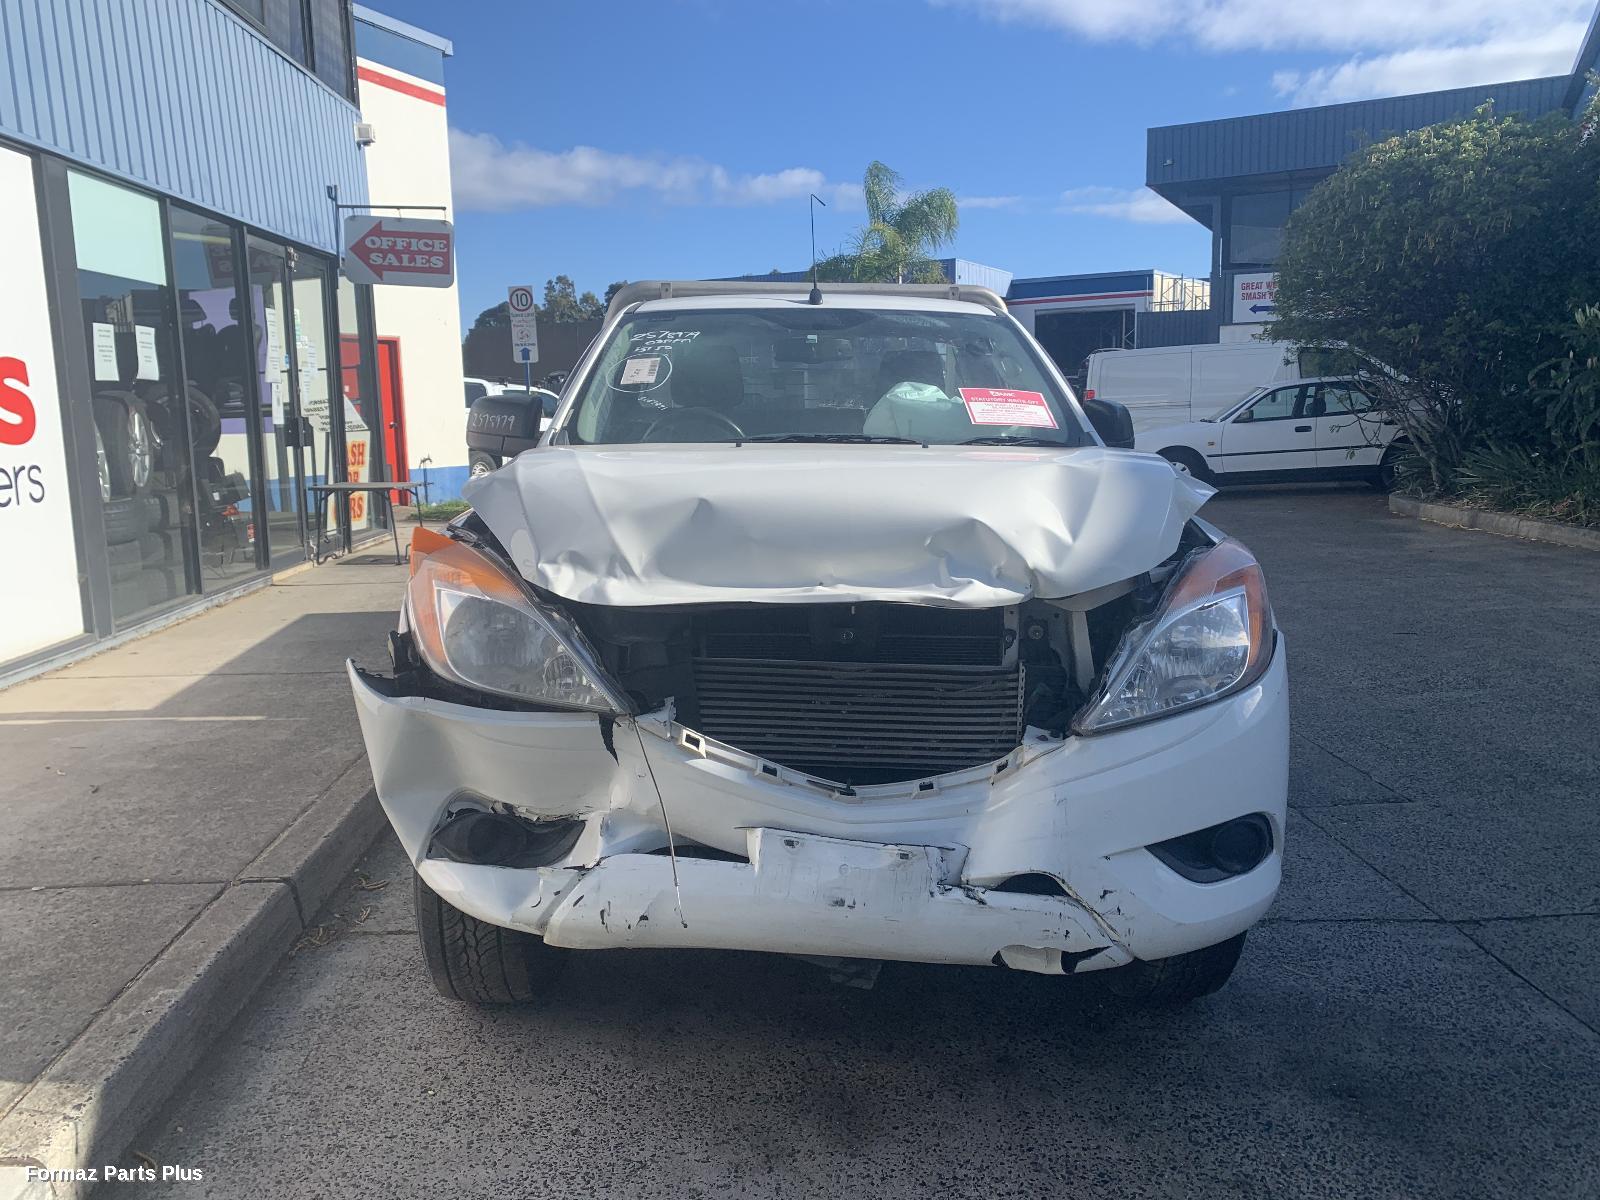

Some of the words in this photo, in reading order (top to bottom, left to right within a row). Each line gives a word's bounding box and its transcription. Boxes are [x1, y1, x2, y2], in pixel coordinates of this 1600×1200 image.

[365, 236, 448, 252] OFFICE
[369, 252, 444, 268] SALES
[1241, 282, 1263, 290] GREAT
[1266, 281, 1278, 289] WE
[515, 293, 529, 307] 10
[1241, 292, 1266, 300] SMASH
[0, 464, 45, 508] ers
